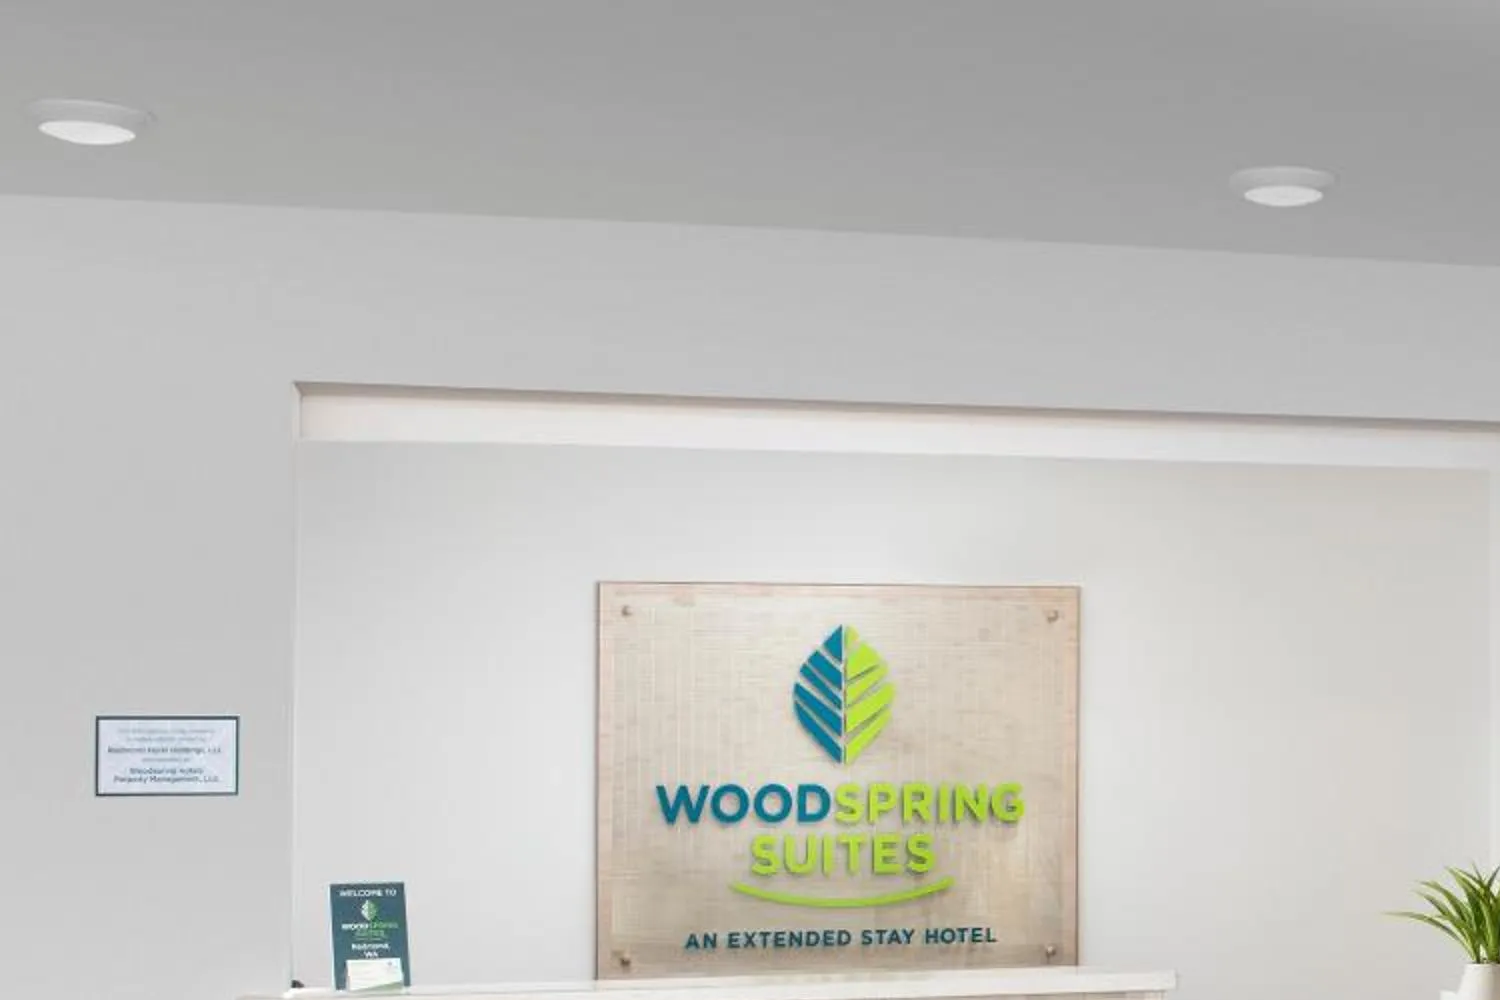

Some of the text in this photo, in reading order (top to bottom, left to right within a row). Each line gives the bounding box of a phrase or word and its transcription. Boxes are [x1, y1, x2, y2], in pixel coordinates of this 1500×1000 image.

[655, 782, 1025, 824] WOODSPRING
[751, 833, 938, 876] SUITES
[339, 888, 397, 897] WELCOME TO
[685, 926, 998, 950] AN EXTENDED STAY HOTEL
